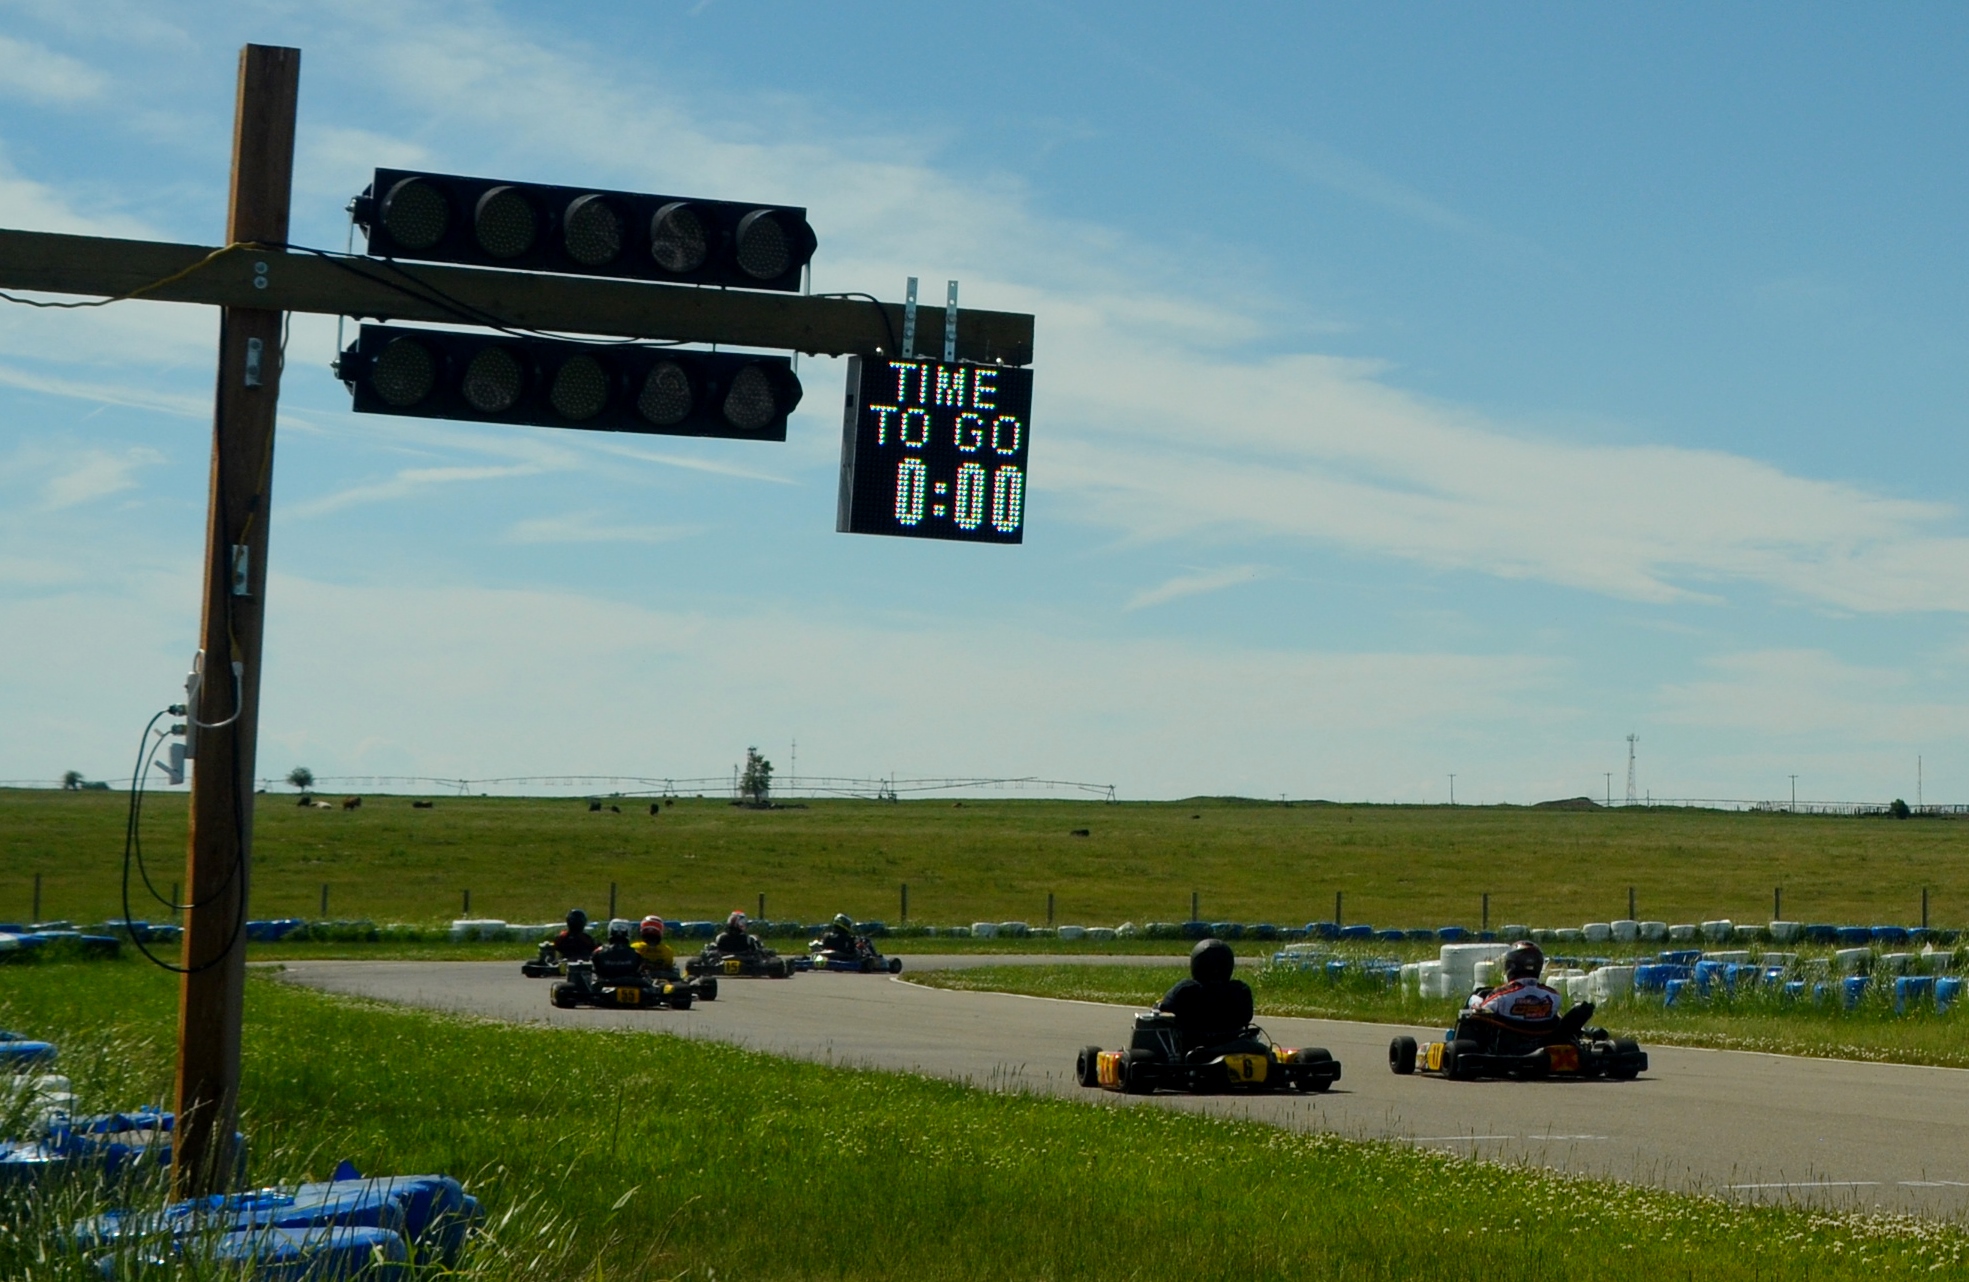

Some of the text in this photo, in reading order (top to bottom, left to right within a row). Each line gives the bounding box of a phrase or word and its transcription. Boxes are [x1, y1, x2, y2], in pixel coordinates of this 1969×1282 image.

[889, 361, 998, 408] TIME
[870, 404, 1021, 455] TO GO
[895, 457, 1023, 532] 0:00
[621, 990, 635, 1002] 55
[1243, 1059, 1252, 1078] 6
